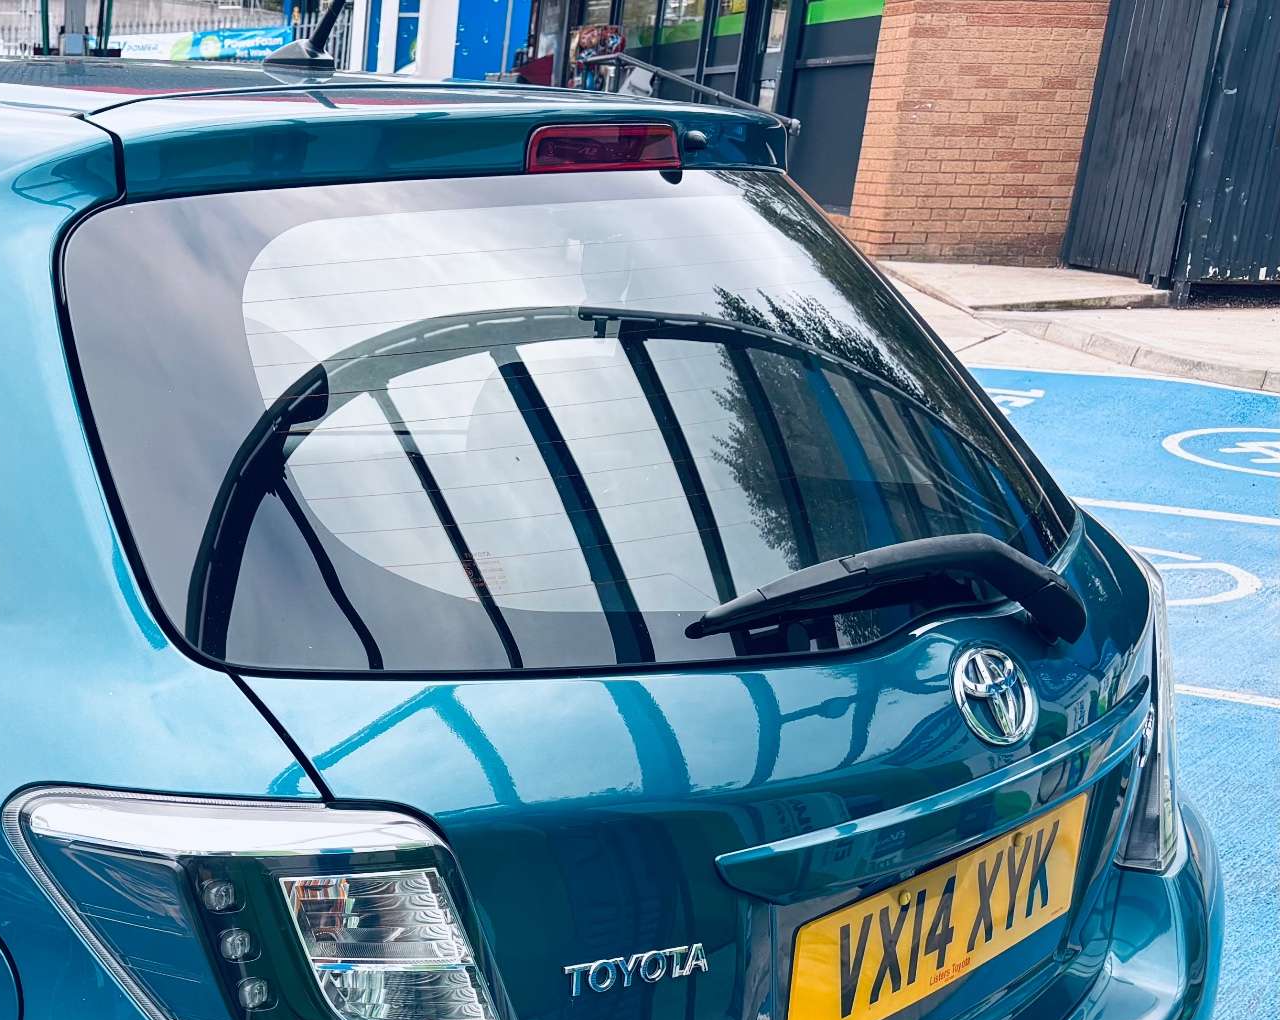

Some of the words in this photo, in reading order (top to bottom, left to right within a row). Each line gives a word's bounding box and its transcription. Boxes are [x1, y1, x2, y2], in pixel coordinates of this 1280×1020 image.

[839, 874, 957, 1019] VX14
[966, 818, 1061, 953] XYK
[563, 942, 709, 997] TOYOTA
[929, 967, 951, 986] Listers
[951, 956, 971, 974] Toyota
